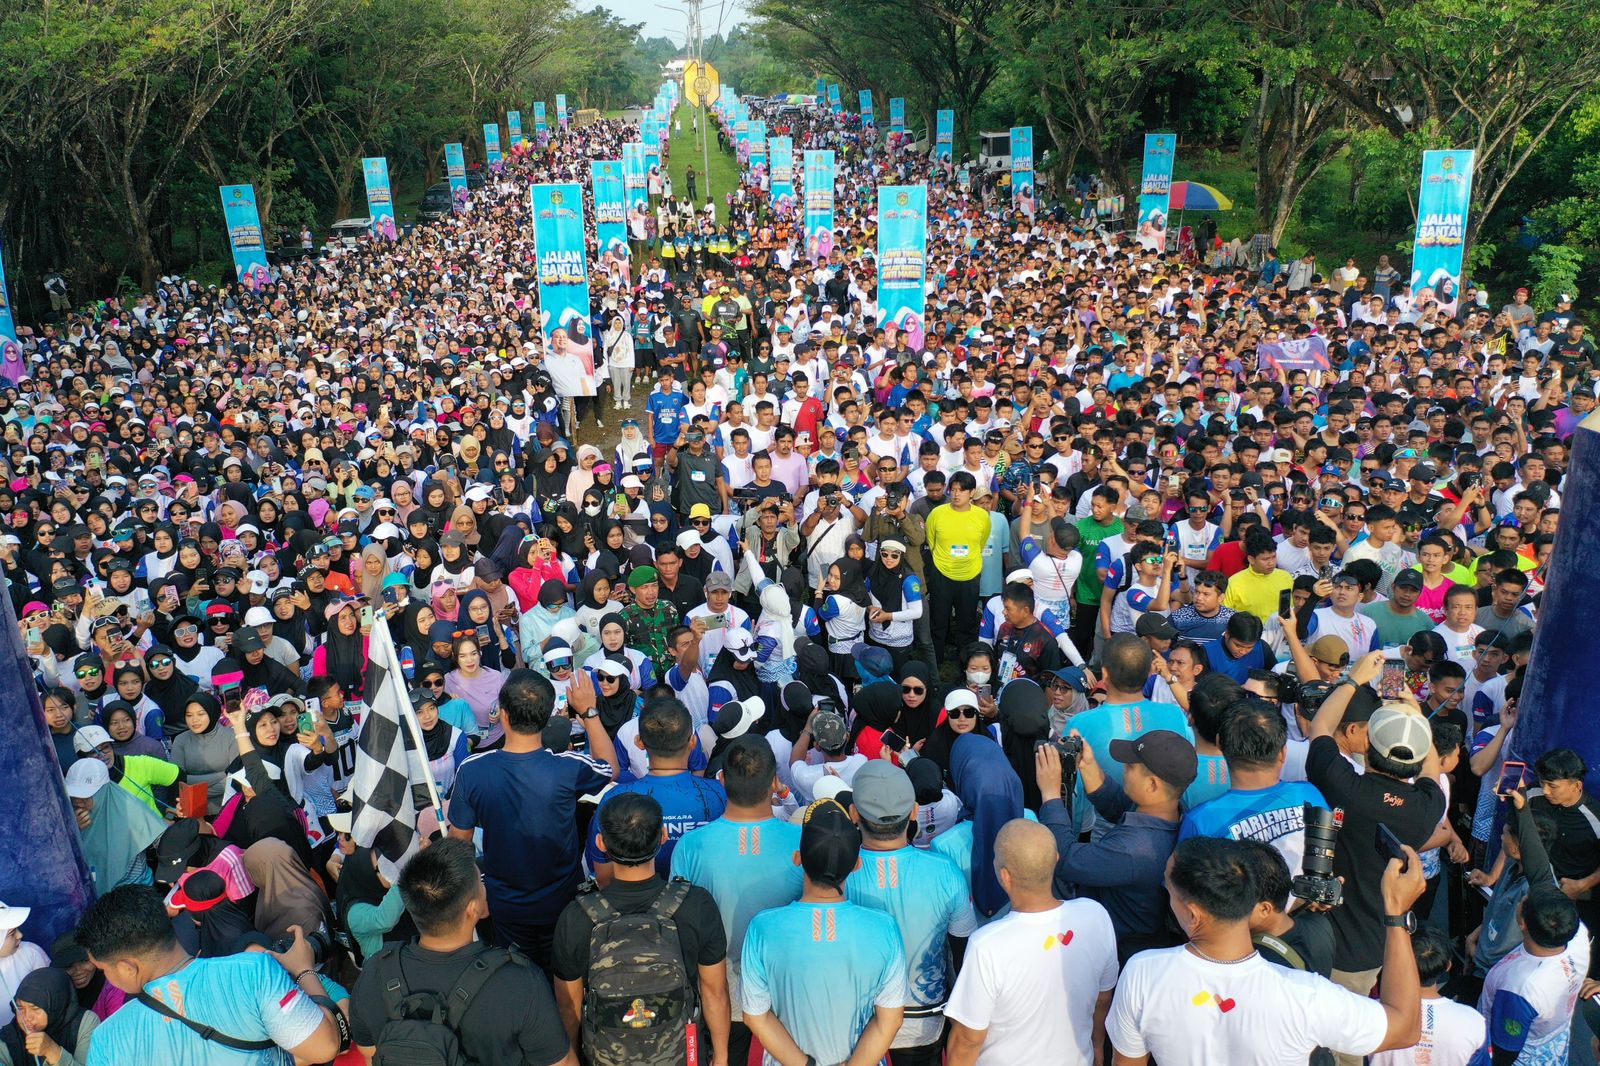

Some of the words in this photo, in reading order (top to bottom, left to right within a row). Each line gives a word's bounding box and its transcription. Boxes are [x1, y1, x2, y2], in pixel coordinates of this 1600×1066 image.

[1145, 174, 1169, 182] JALAN
[598, 201, 622, 210] JALAN
[597, 209, 624, 217] SANTAI
[1422, 213, 1462, 225] JALAN
[1418, 225, 1462, 237] SANTAI
[541, 250, 582, 263] JALAN
[541, 263, 584, 276] SANTAI
[336, 1012, 349, 1041] SONY
